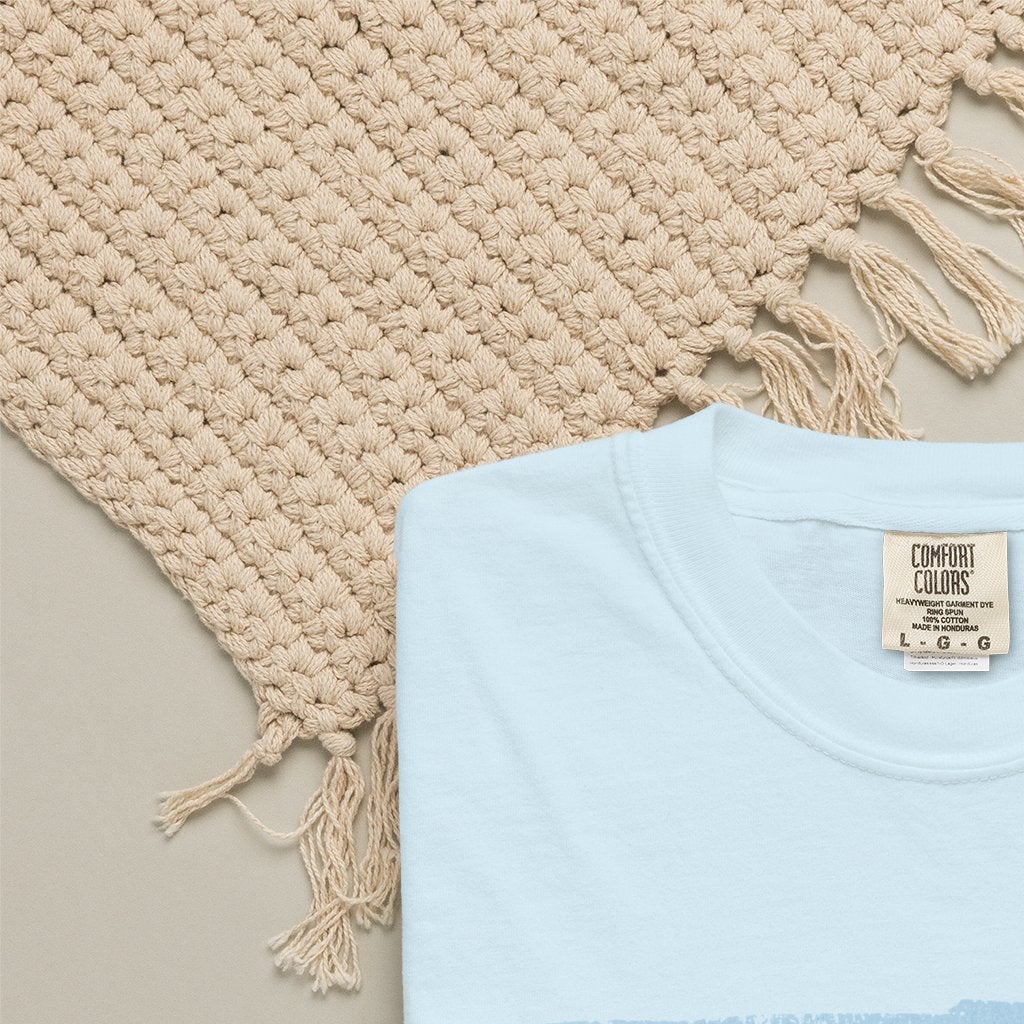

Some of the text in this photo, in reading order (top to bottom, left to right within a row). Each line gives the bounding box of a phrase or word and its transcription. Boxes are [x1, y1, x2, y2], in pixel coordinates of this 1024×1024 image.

[911, 543, 976, 568] COMFORT
[896, 598, 994, 609] HEAVYWEIGHT GARMENT DYE
[926, 608, 944, 616] RING
[922, 616, 969, 624] 100% COTTON
[912, 623, 979, 632] MADE IN HONDURAS
[899, 633, 911, 648] L
[936, 635, 951, 650] G
[977, 635, 991, 651] G
